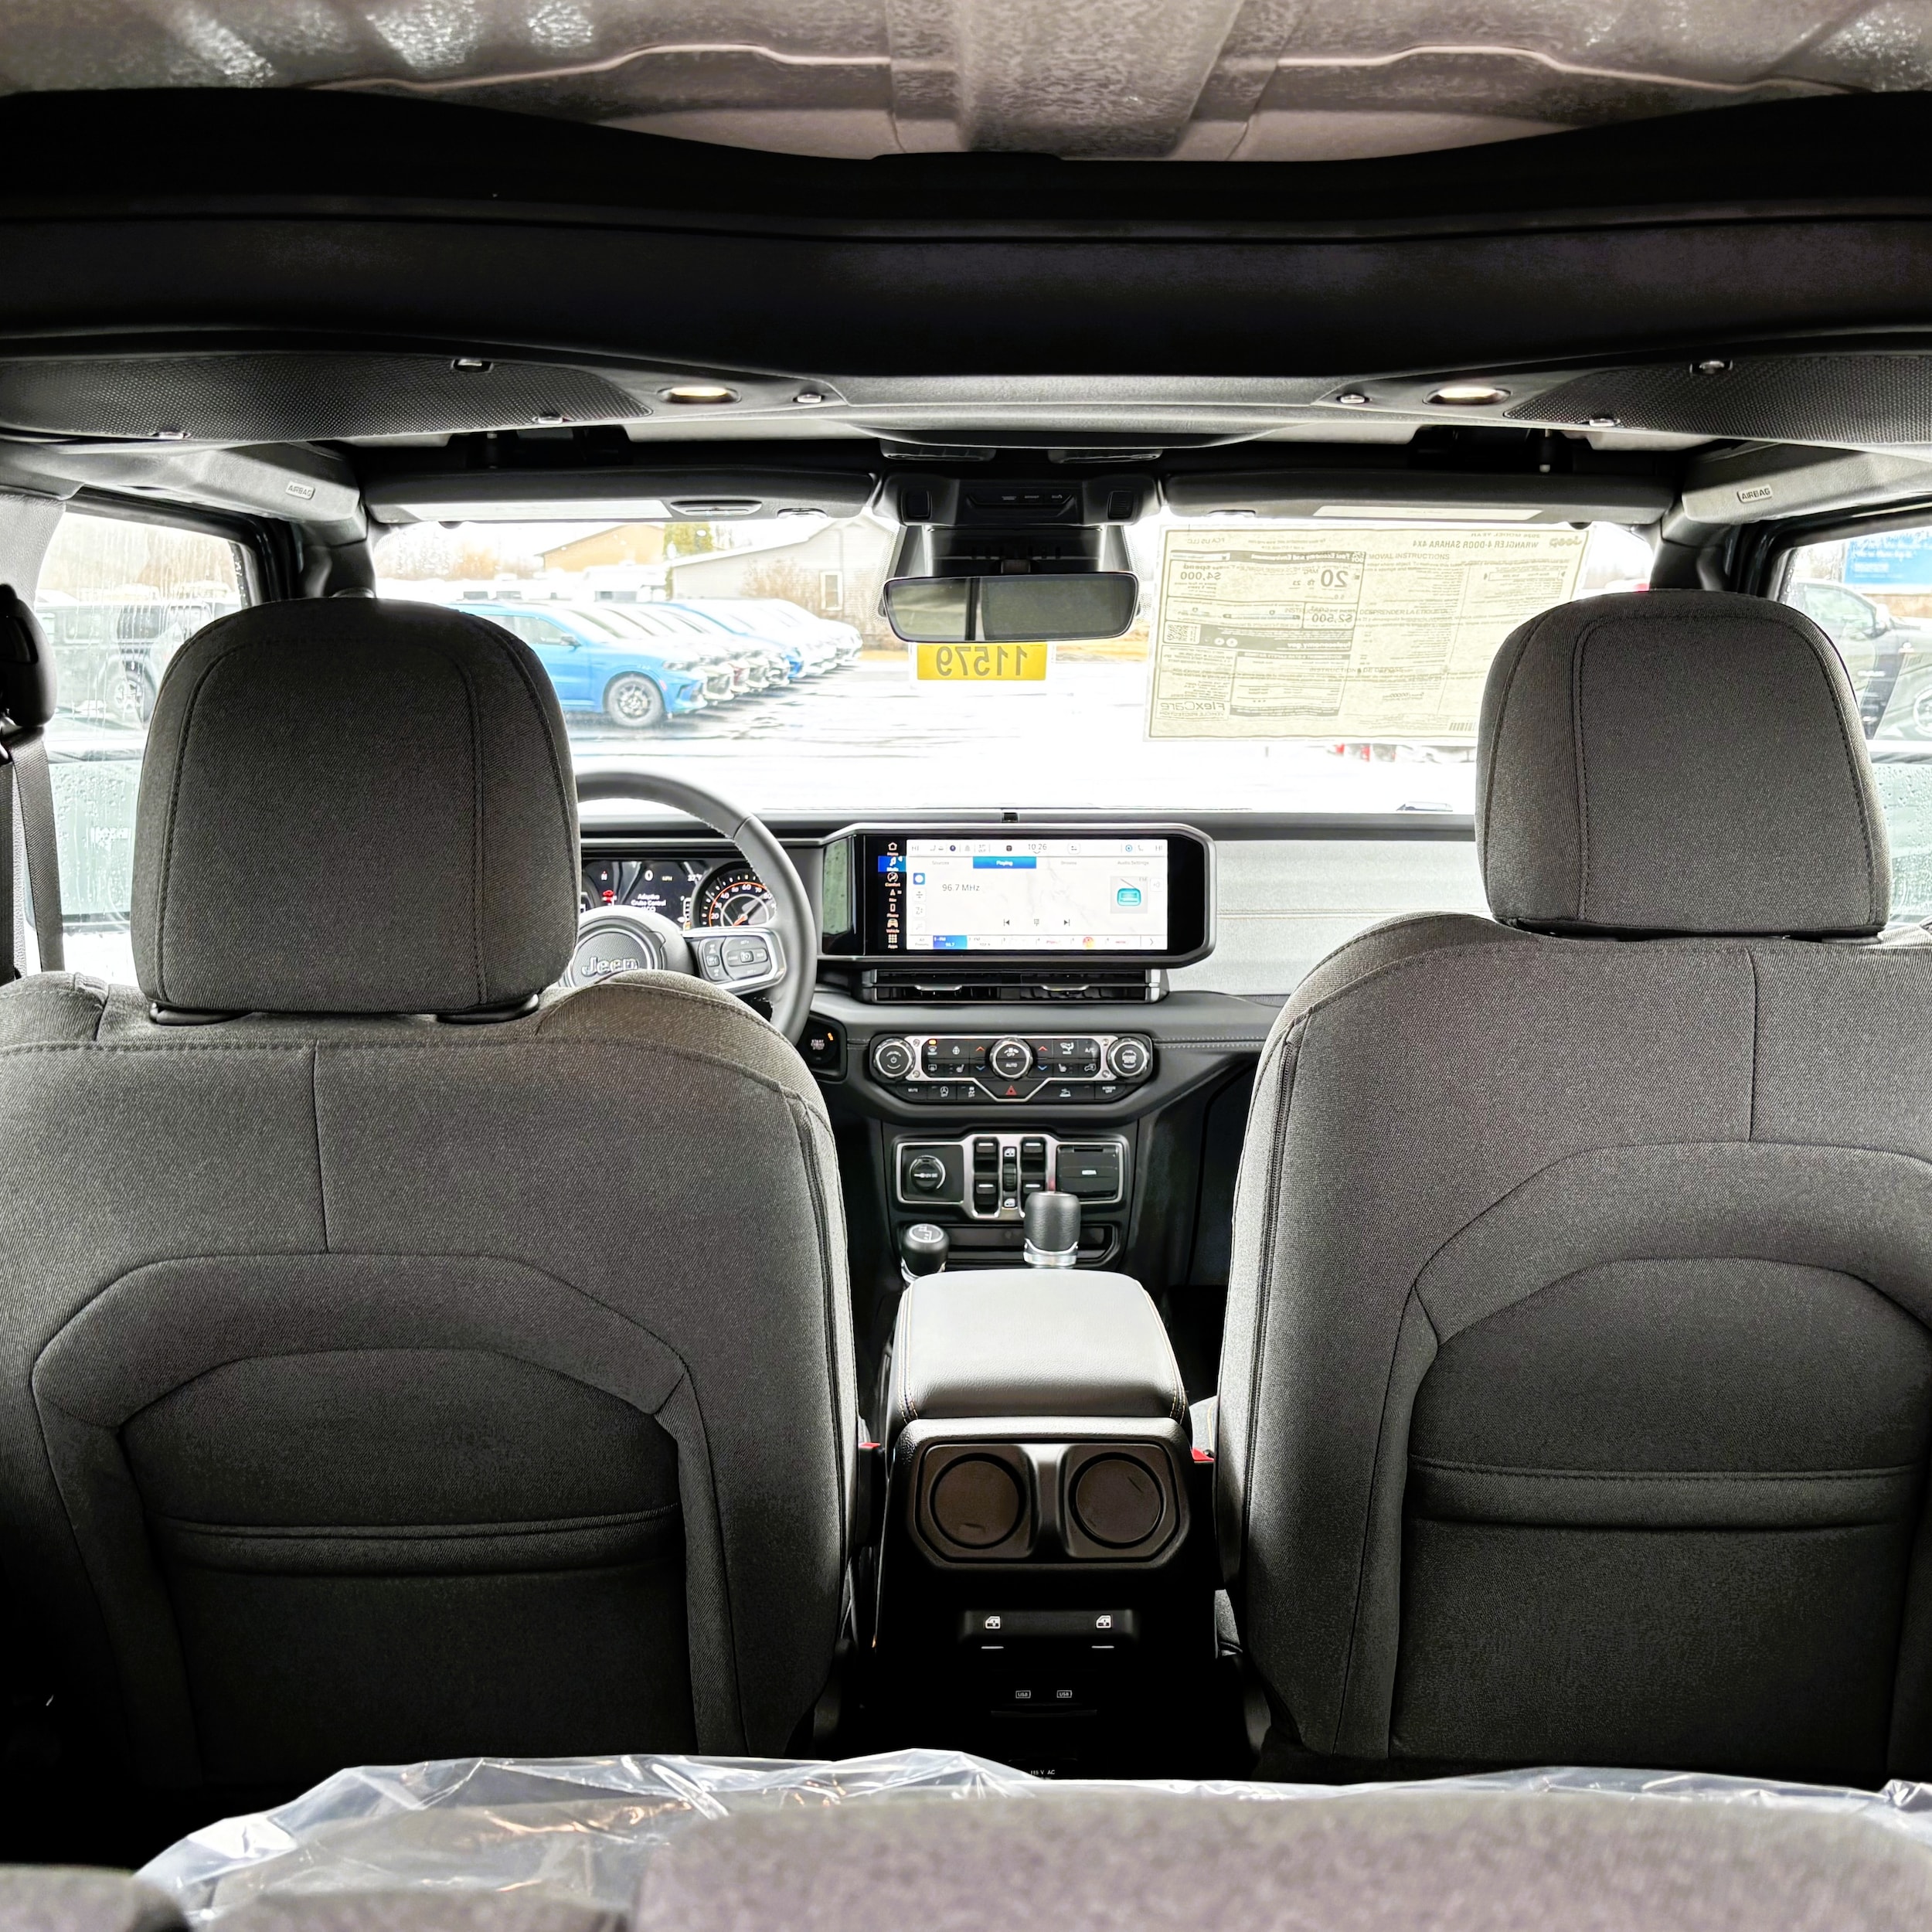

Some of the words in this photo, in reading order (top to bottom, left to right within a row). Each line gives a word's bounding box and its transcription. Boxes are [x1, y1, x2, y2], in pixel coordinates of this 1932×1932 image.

[288, 485, 312, 497] AIRBAG
[1742, 488, 1770, 500] AIRBAG
[581, 957, 638, 977] Jeep
